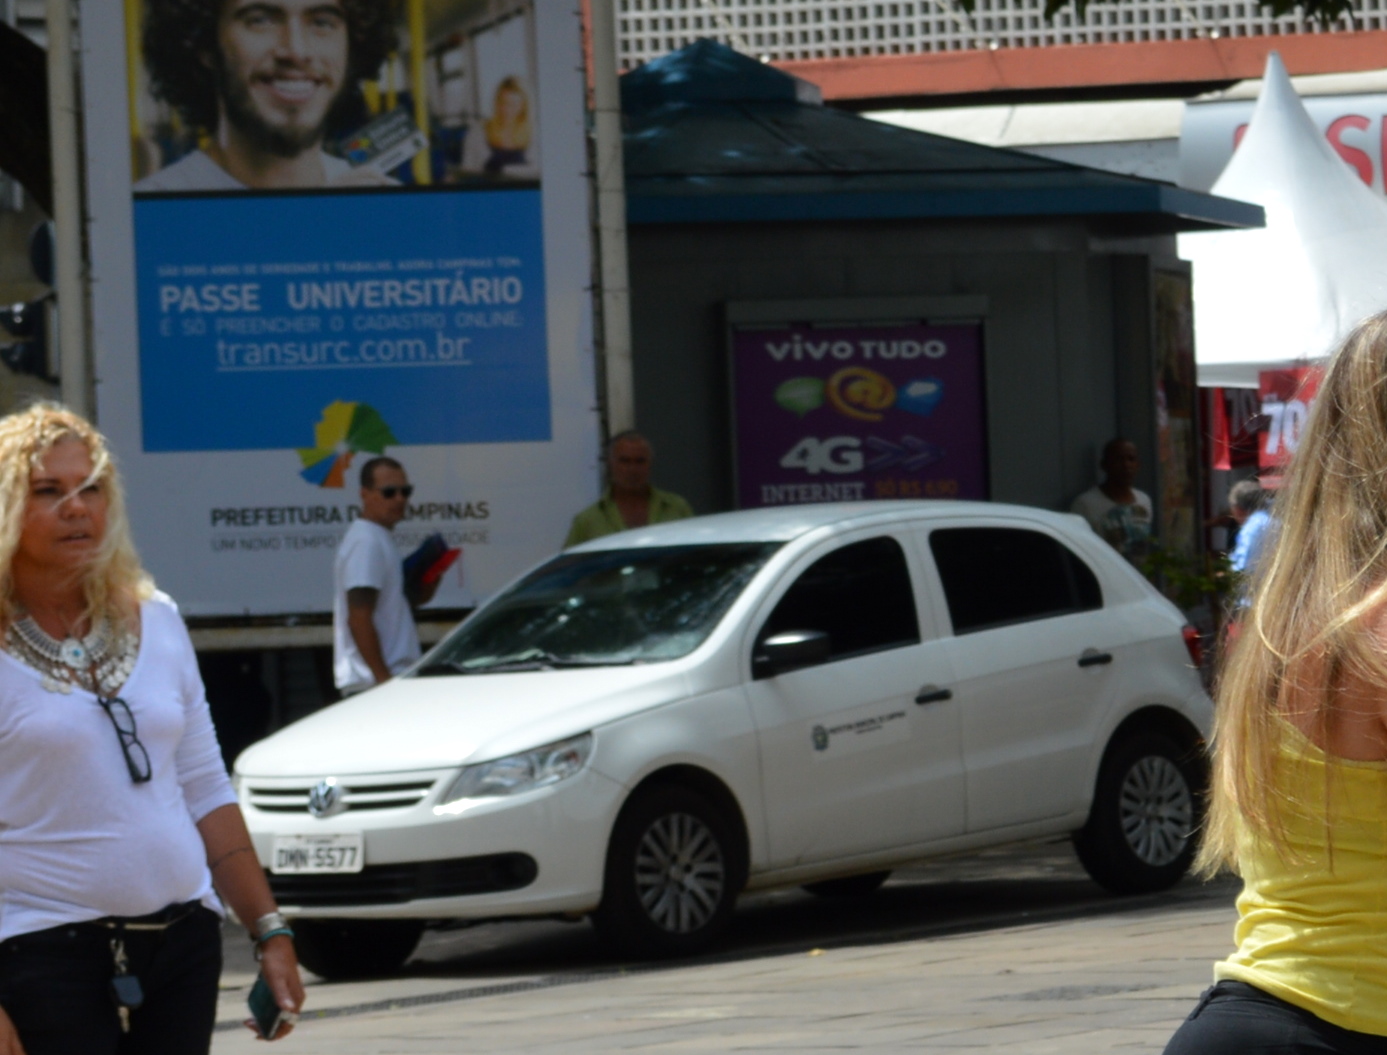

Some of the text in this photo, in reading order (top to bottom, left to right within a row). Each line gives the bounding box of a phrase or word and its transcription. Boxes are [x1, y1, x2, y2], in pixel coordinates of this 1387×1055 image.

[159, 270, 523, 313] PASSE UNIVERSITÁRIO
[160, 315, 172, 337] É
[181, 315, 206, 335] SÓ
[216, 315, 322, 334] PREENCHER
[329, 314, 345, 332] O
[353, 312, 447, 331] CADASTRO
[216, 331, 472, 367] transurc.com.br
[859, 339, 947, 360] TUDO
[779, 435, 865, 475] 4G
[761, 481, 866, 503] INTERNET
[210, 505, 343, 527] PREFEITURA
